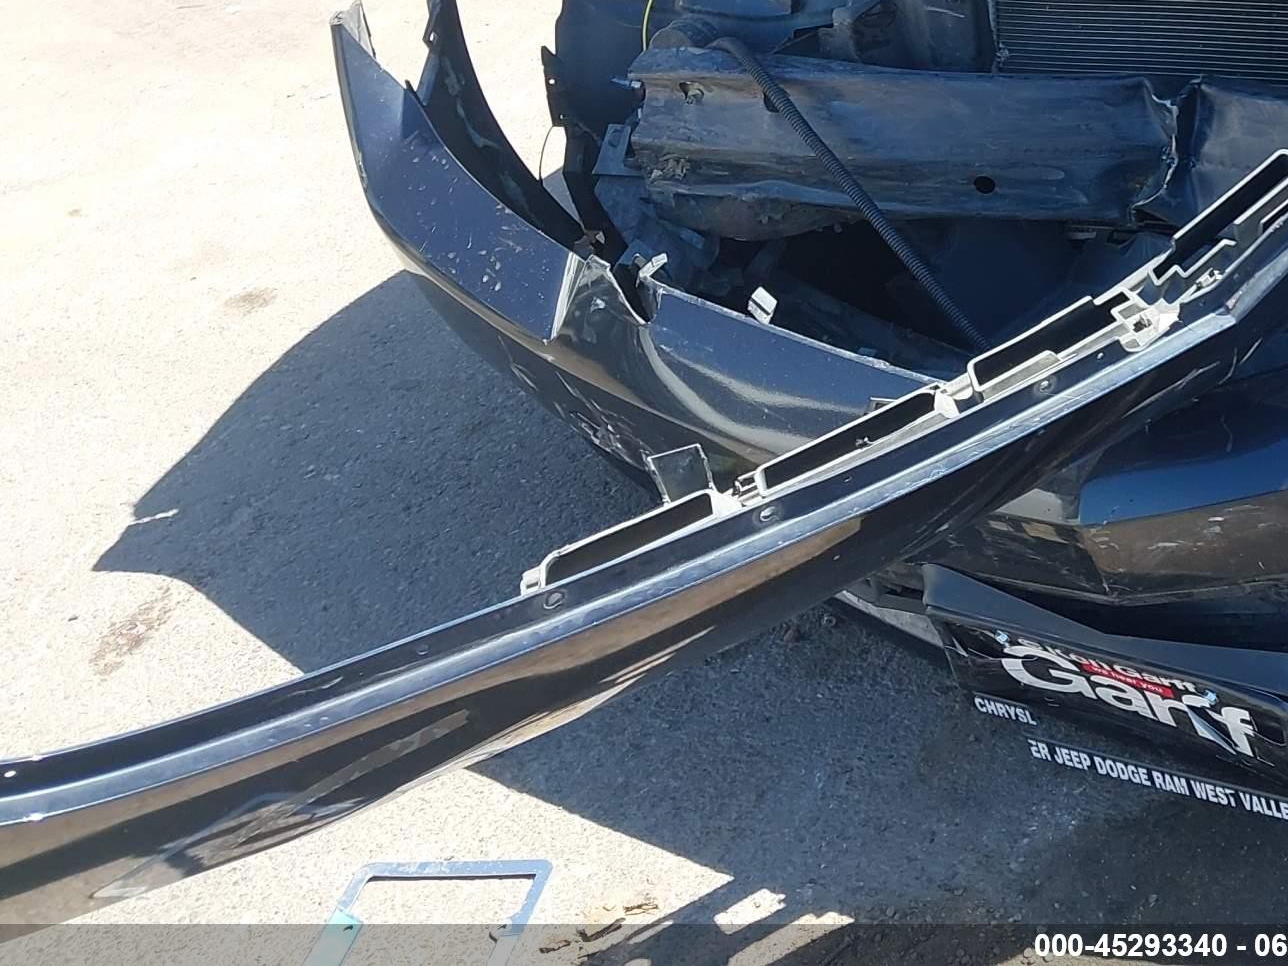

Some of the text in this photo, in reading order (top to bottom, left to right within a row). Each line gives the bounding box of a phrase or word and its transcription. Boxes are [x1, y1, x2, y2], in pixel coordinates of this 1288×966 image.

[973, 695, 1037, 725] CHRYSL
[1053, 746, 1092, 771] JEEP
[1094, 756, 1152, 786] DODGE
[1152, 770, 1189, 796] RAM
[1190, 779, 1236, 808] WEST
